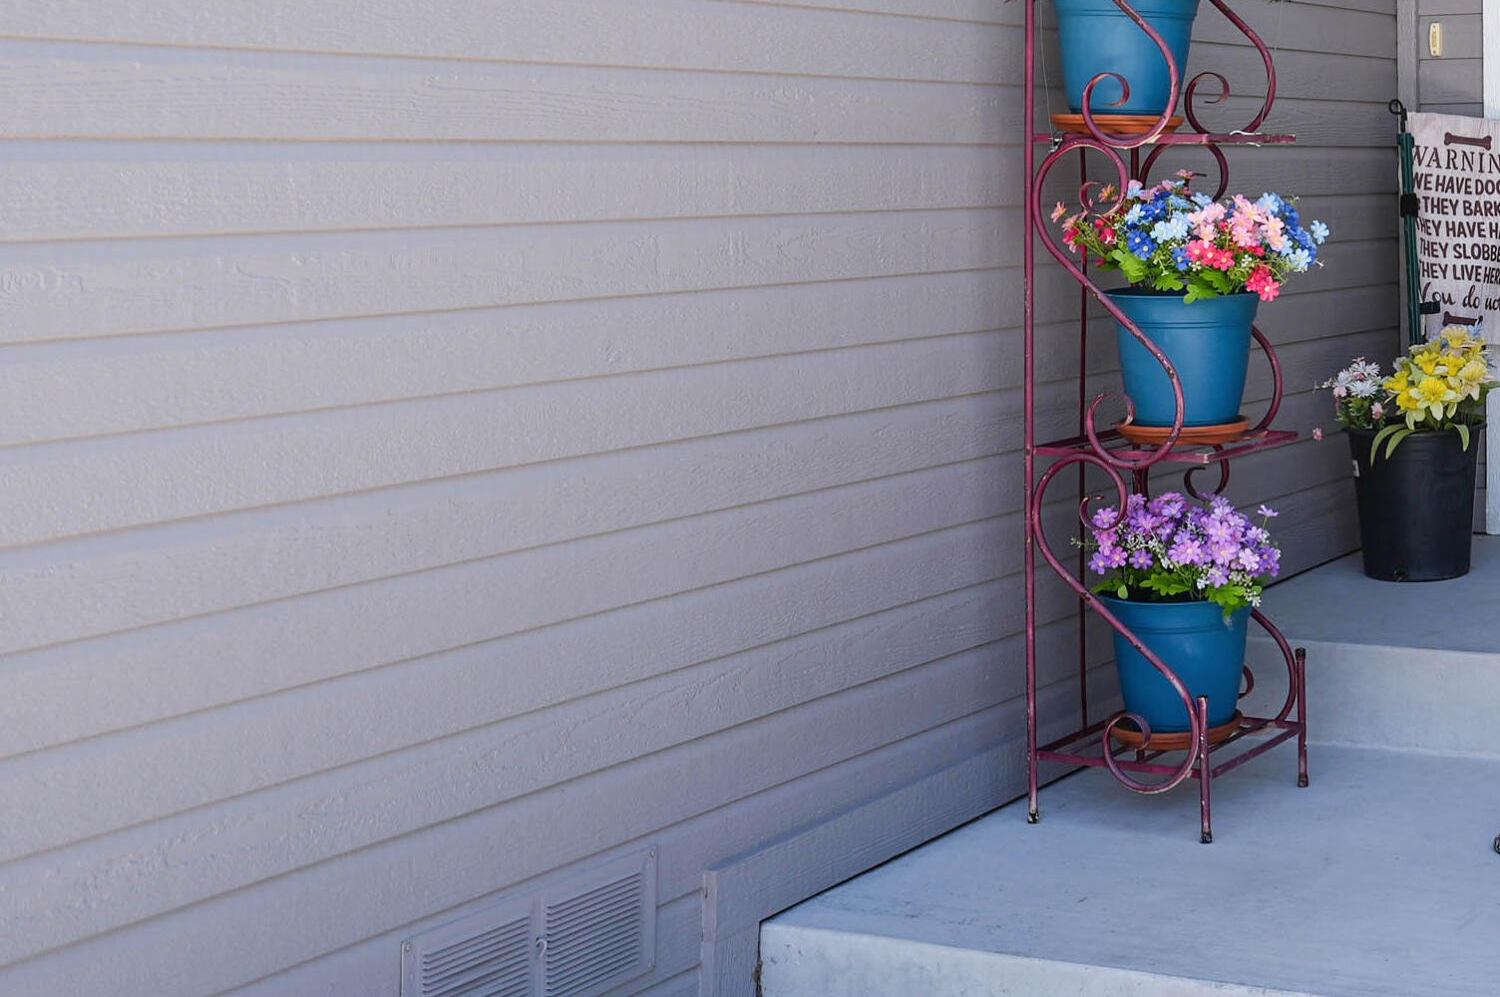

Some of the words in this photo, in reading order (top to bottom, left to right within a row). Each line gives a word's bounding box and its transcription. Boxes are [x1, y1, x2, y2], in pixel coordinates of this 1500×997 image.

[1413, 172, 1433, 191] WE
[1435, 174, 1472, 195] HAVE
[1422, 196, 1459, 216] THEY
[1446, 221, 1486, 238] HAVE
[1420, 238, 1449, 259] THEY
[1453, 264, 1482, 283] LIVE
[1462, 285, 1481, 309] do
